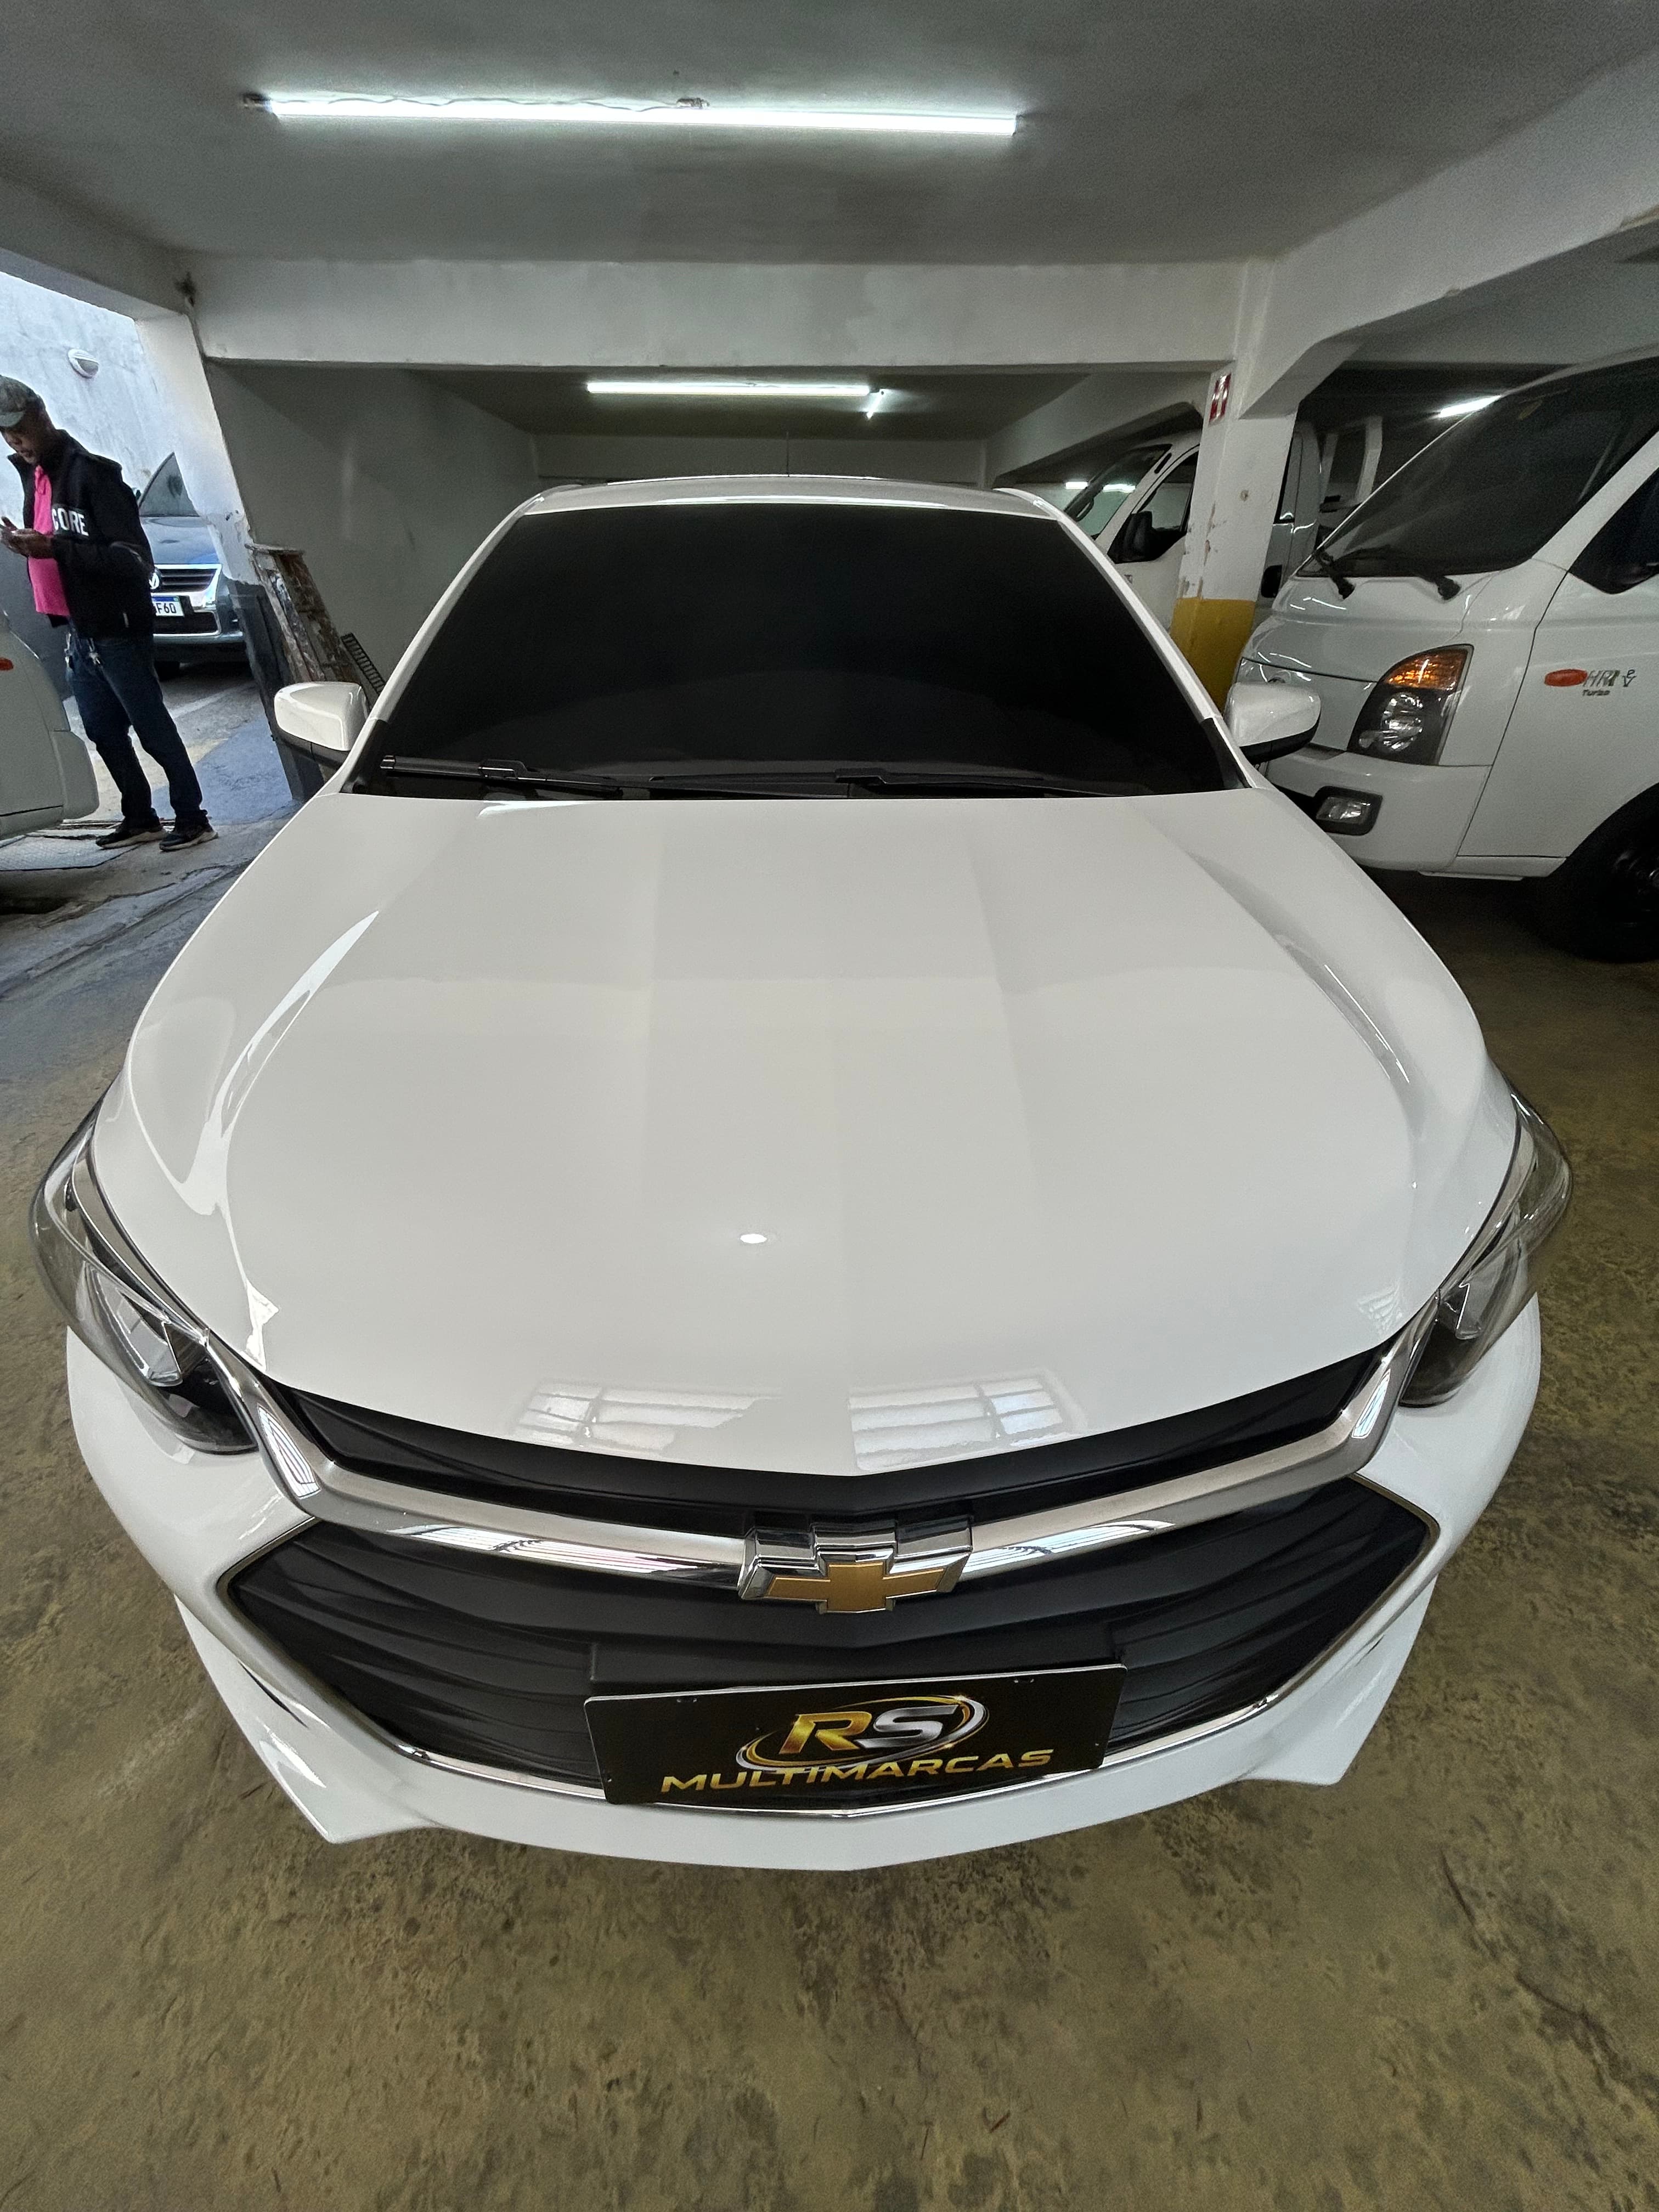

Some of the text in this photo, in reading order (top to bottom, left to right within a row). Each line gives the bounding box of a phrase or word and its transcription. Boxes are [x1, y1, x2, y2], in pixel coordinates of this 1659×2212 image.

[52, 508, 89, 536] CORE
[778, 1705, 959, 1754] RS
[660, 1748, 1054, 1793] MULTIMARCAS
